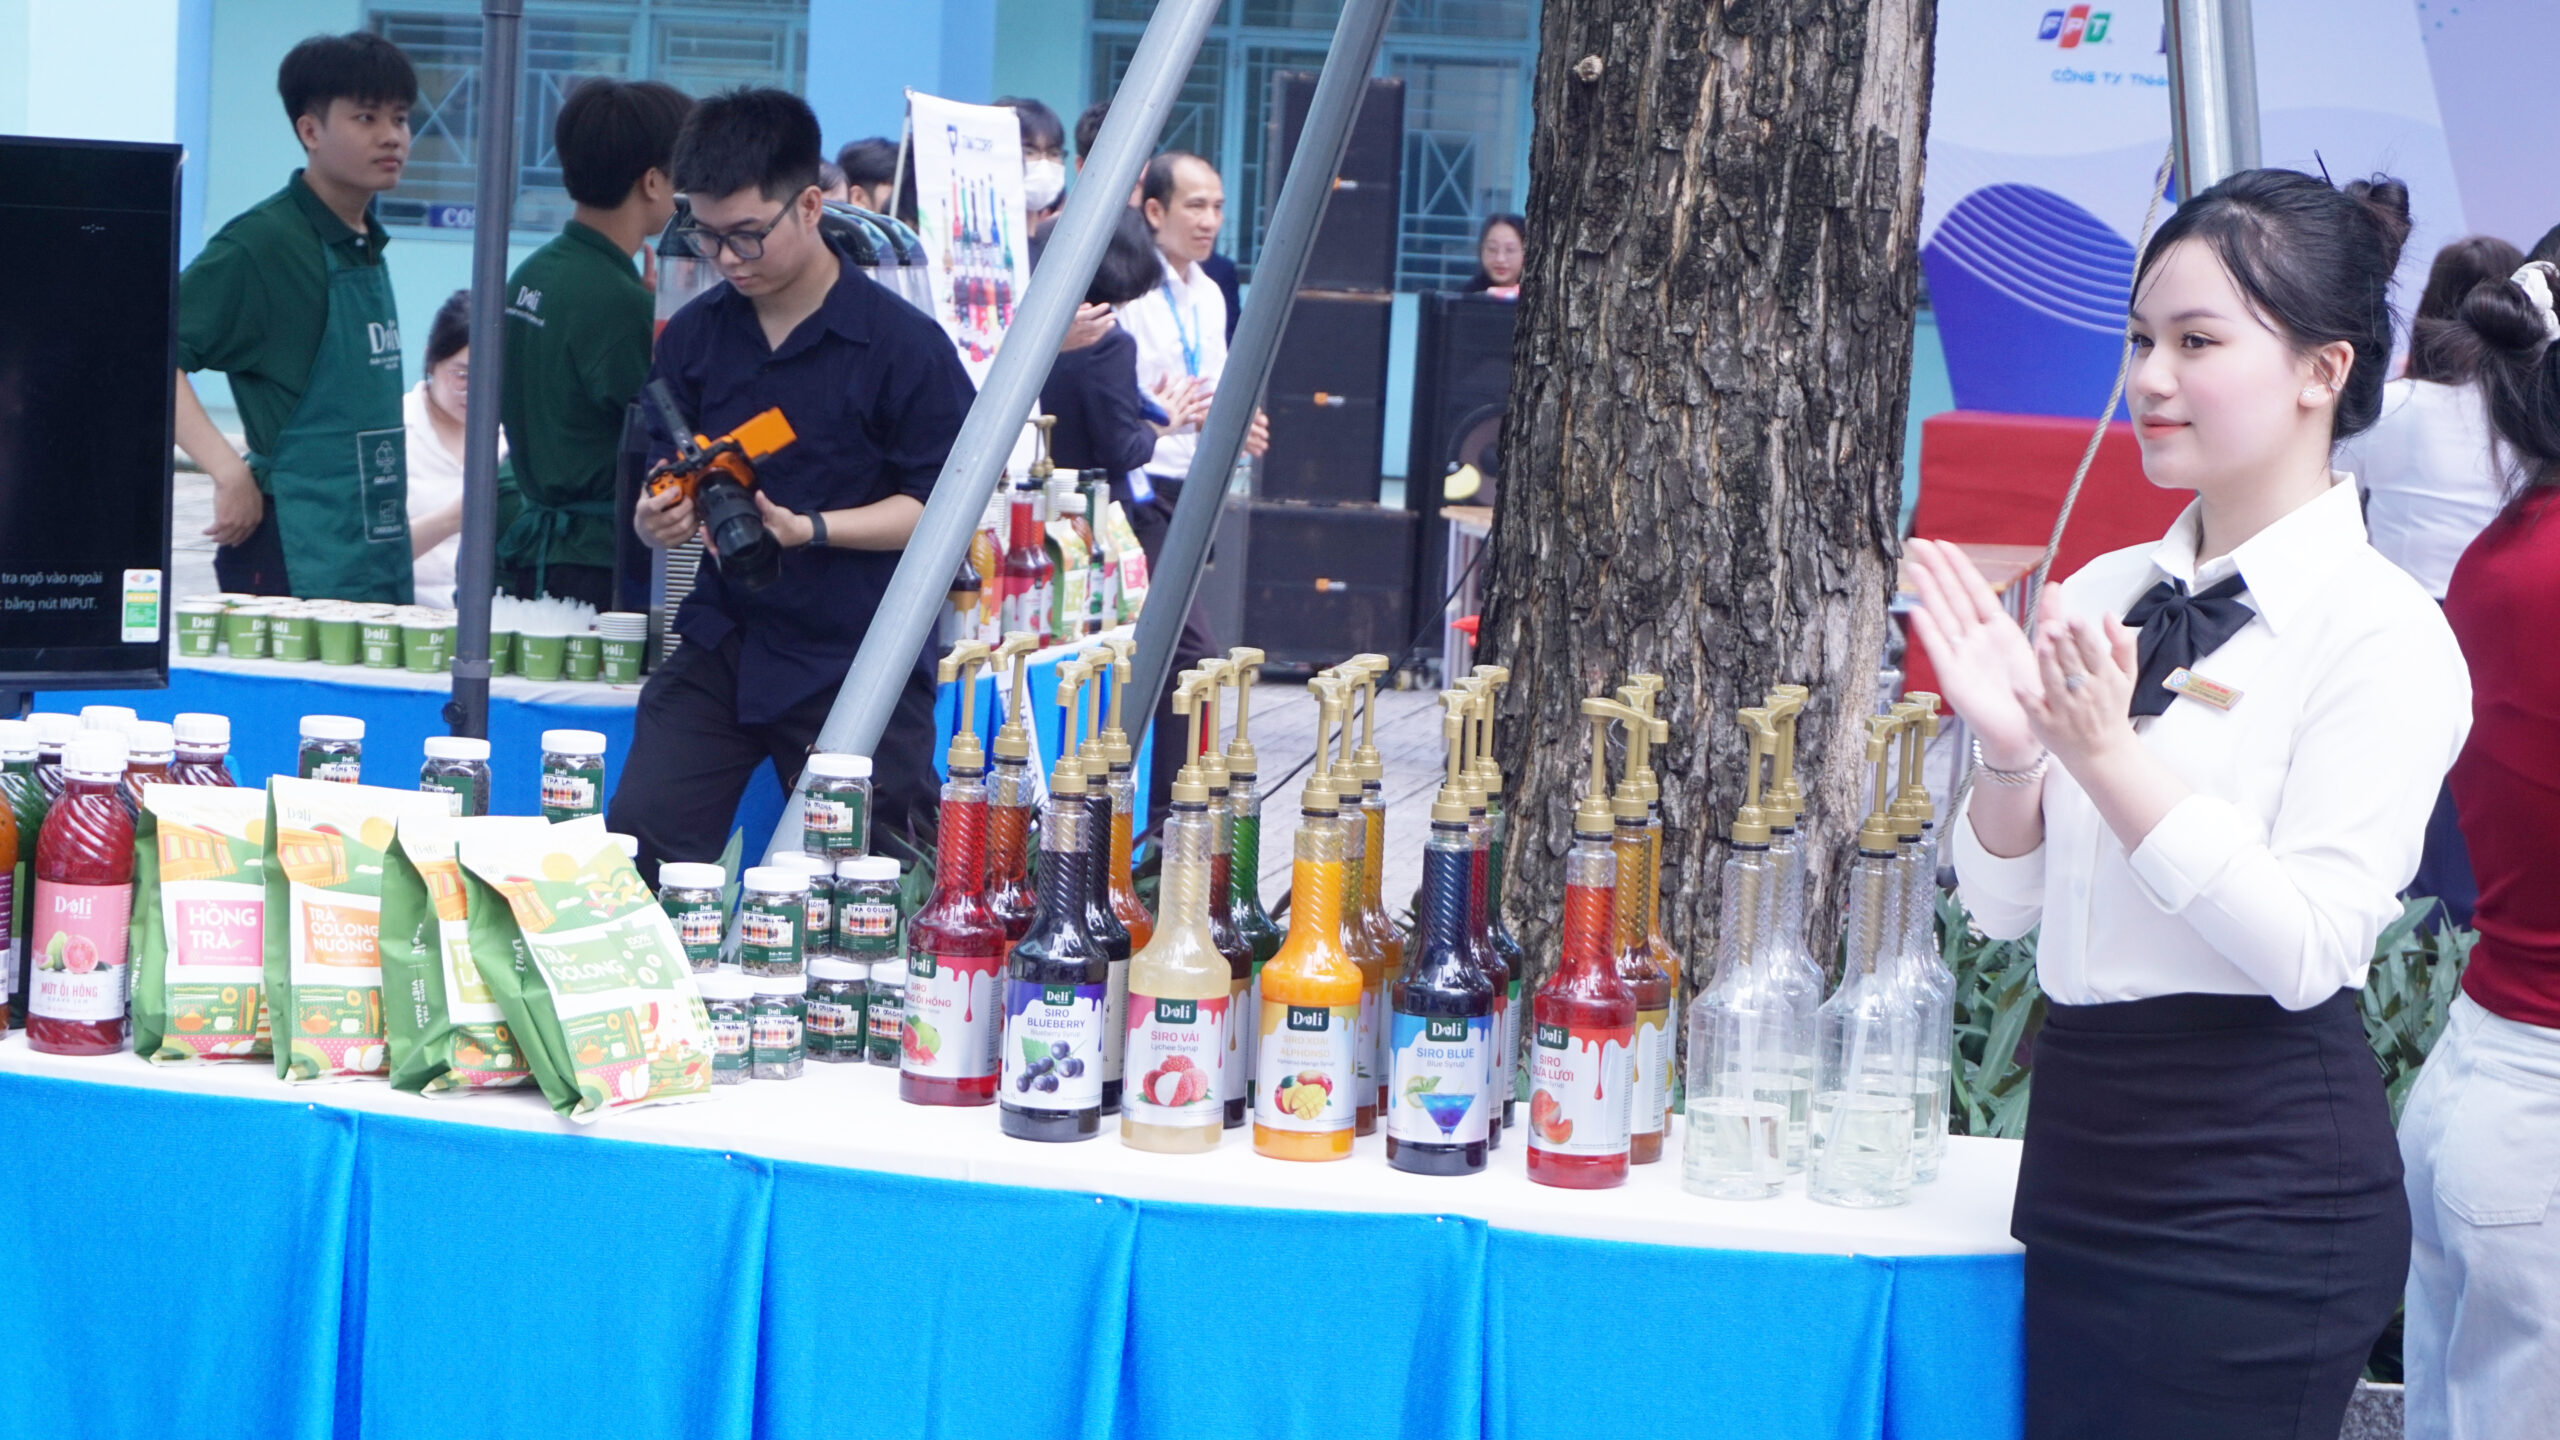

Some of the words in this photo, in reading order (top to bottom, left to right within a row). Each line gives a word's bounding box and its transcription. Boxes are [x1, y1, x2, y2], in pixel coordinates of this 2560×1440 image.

[2038, 4, 2111, 49] FPT
[2, 573, 17, 584] tra
[45, 572, 67, 584] vào
[70, 572, 103, 587] ngoài
[187, 899, 257, 927] HỒNG
[310, 921, 379, 938] OOLONG
[188, 925, 232, 950] TRÀ
[1045, 1008, 1070, 1018] SIRO
[1027, 1017, 1085, 1028] BLUEBERRY
[1151, 1031, 1178, 1042] SIRO
[1151, 1043, 1175, 1051] Lychee
[1177, 1044, 1198, 1052] Syrup
[1416, 1047, 1444, 1058] SIRO
[1447, 1048, 1475, 1059] BLUE
[1539, 1054, 1561, 1067] SIRO
